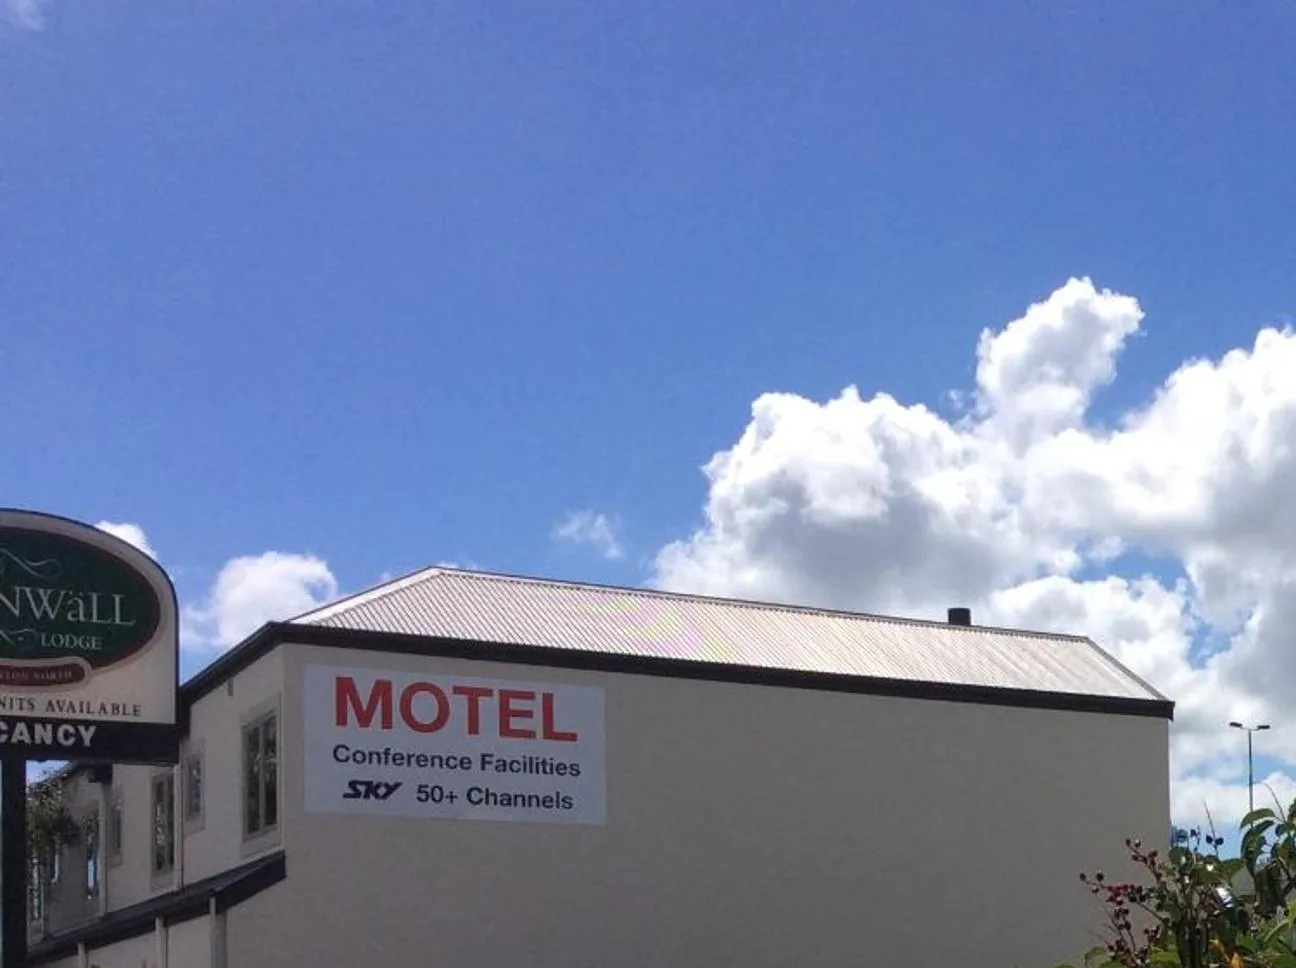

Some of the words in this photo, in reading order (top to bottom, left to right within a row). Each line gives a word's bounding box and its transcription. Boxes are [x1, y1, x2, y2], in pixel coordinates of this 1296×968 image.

[41, 633, 102, 651] LODGE
[46, 699, 142, 717] AVAILABLE
[335, 676, 578, 742] MOTEL
[333, 744, 473, 772] Conference
[480, 753, 581, 777] Facilities
[342, 780, 403, 800] SKY
[416, 784, 459, 804] 50+
[467, 787, 574, 810] Channels
